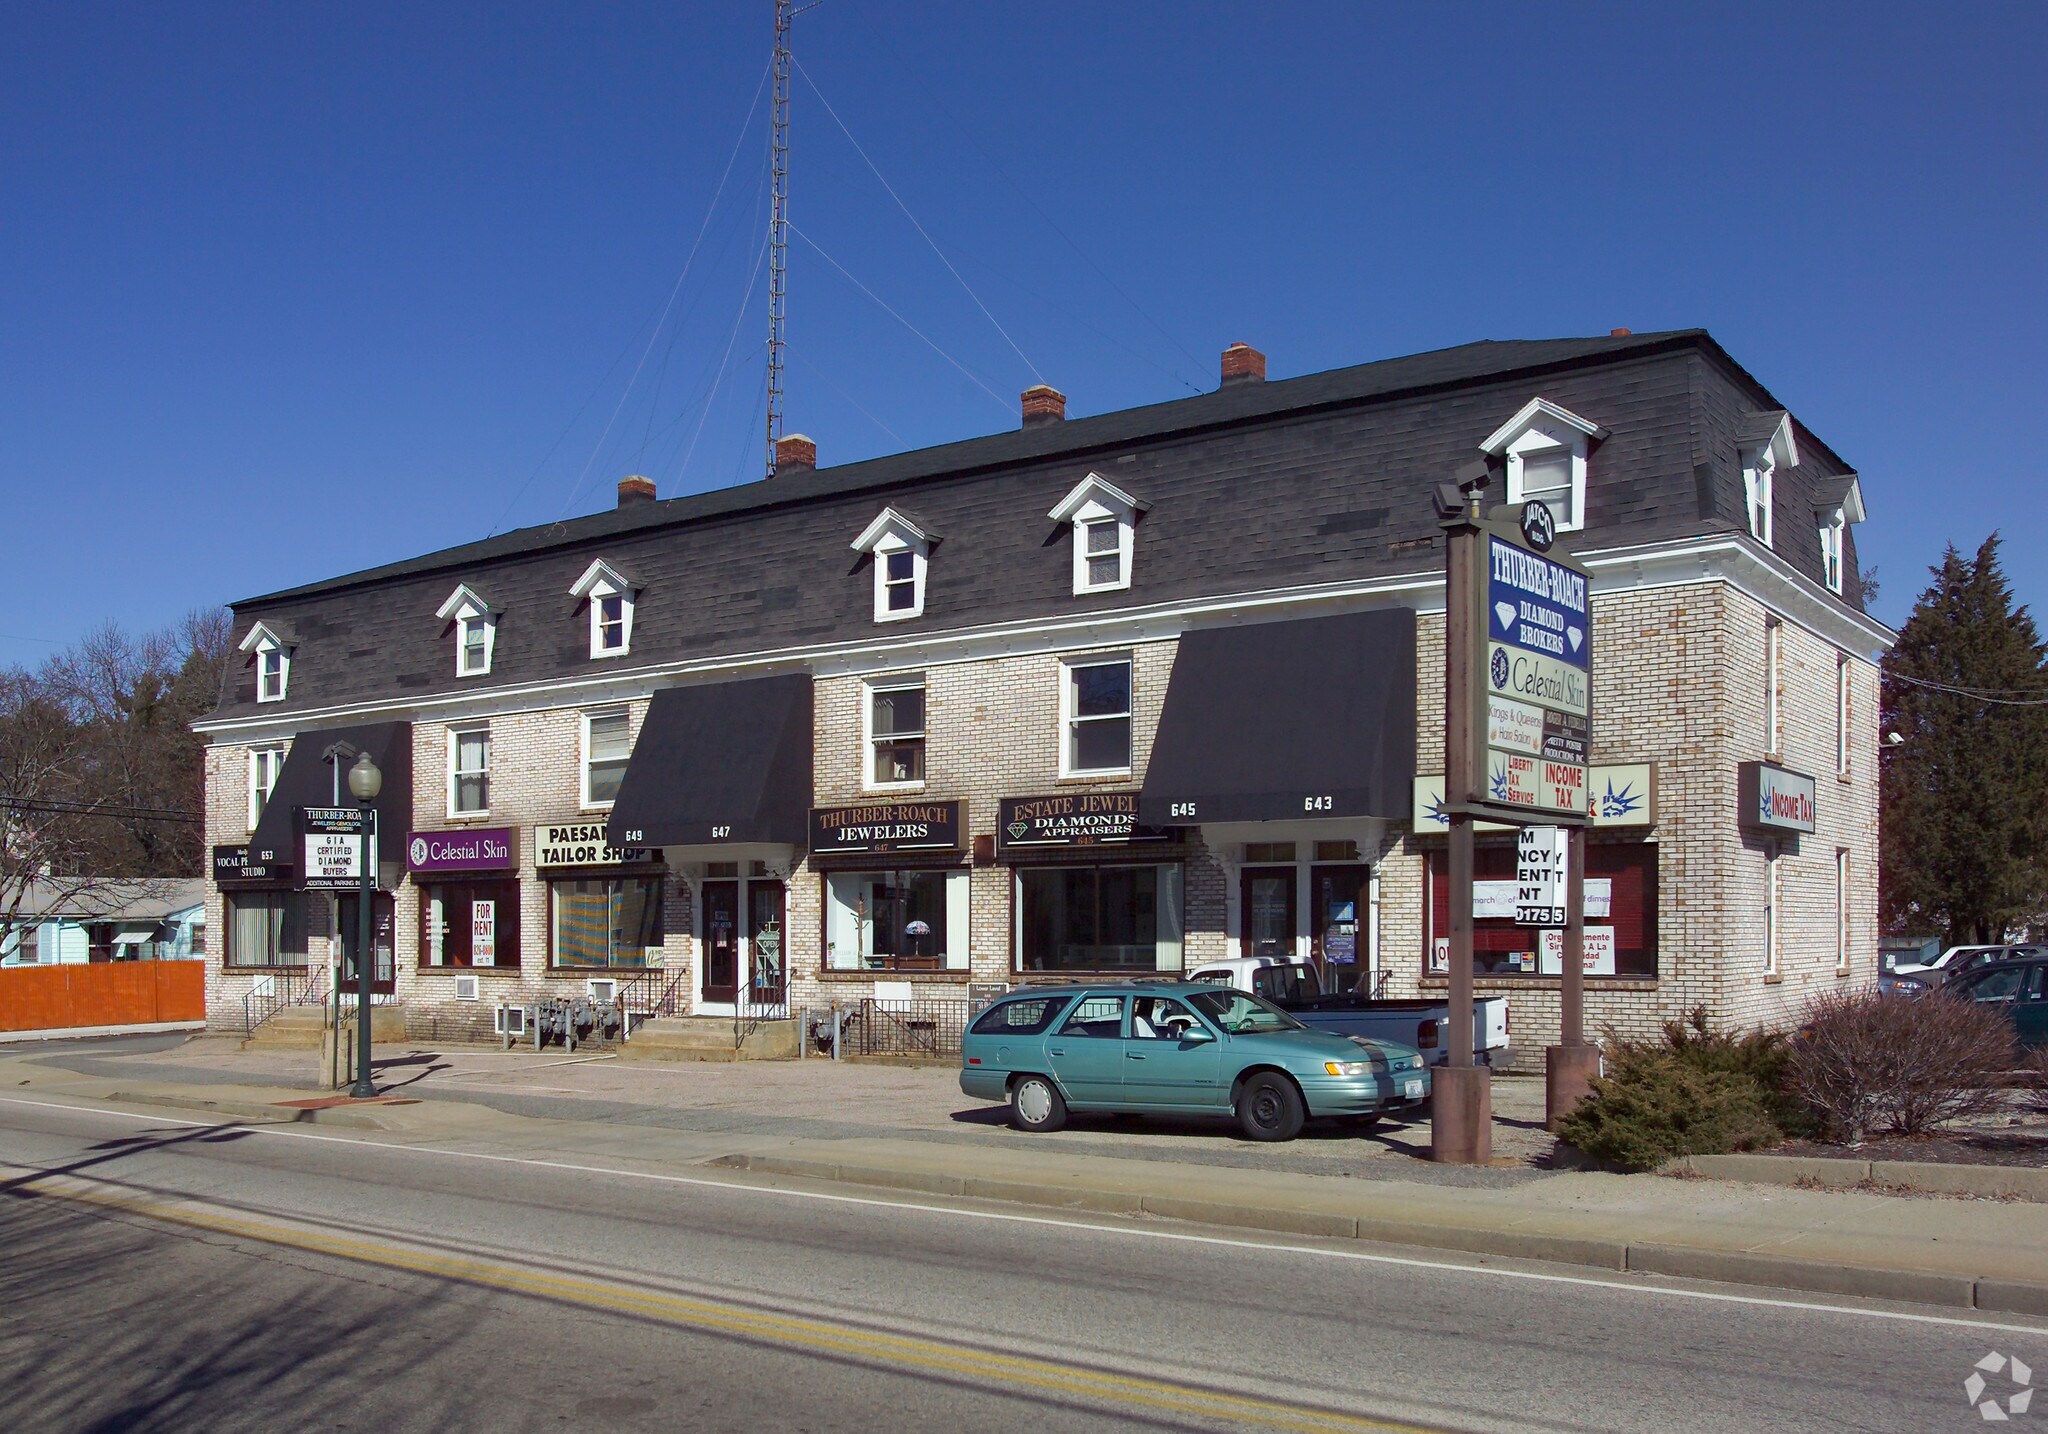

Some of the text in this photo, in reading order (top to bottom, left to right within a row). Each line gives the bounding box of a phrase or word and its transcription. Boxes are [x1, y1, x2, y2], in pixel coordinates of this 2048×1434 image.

[1525, 503, 1552, 542] JATCO
[1492, 541, 1585, 613] THURBER-ROACH
[1520, 600, 1564, 632] DIAMOND
[1520, 625, 1563, 655] BROKERS
[1513, 657, 1563, 702] Celestial
[1567, 673, 1585, 709] Skin
[1488, 704, 1542, 728] Kings & Queens
[1499, 726, 1531, 745] Hair Salon
[1508, 753, 1534, 772] LIBERTY
[1508, 770, 1520, 787] TAX
[1545, 763, 1582, 788] INCOME
[1304, 796, 1332, 811] 643
[1508, 787, 1534, 805] SERVICE
[1555, 787, 1573, 809] TAX
[1772, 785, 1813, 823] INCOME TAX
[1013, 795, 1139, 821] ESTATE JEWEL
[1171, 802, 1196, 817] 645
[820, 805, 948, 830] THURBER-ROACH
[1034, 813, 1139, 828] DIAMONDS
[549, 825, 607, 843] PAESAN
[625, 830, 643, 842] 649
[712, 826, 730, 838] 647
[838, 823, 928, 842] JEWELERS
[1042, 825, 1132, 837] APPRAISERS
[874, 843, 889, 852] 647
[1077, 836, 1094, 845] 645
[261, 850, 274, 860] 653
[317, 847, 352, 855] CERTIFIED
[430, 840, 479, 861] Celestial
[483, 839, 508, 859] Skin
[542, 845, 646, 864] TAILOR SHOP
[216, 857, 240, 867] VOCAL
[318, 857, 352, 865] DIAMOND
[241, 866, 266, 877] STUDIO
[322, 867, 348, 876] BUYERS
[1473, 895, 1610, 904] march of dimes
[476, 903, 491, 919] FOR
[474, 921, 493, 936] RENT
